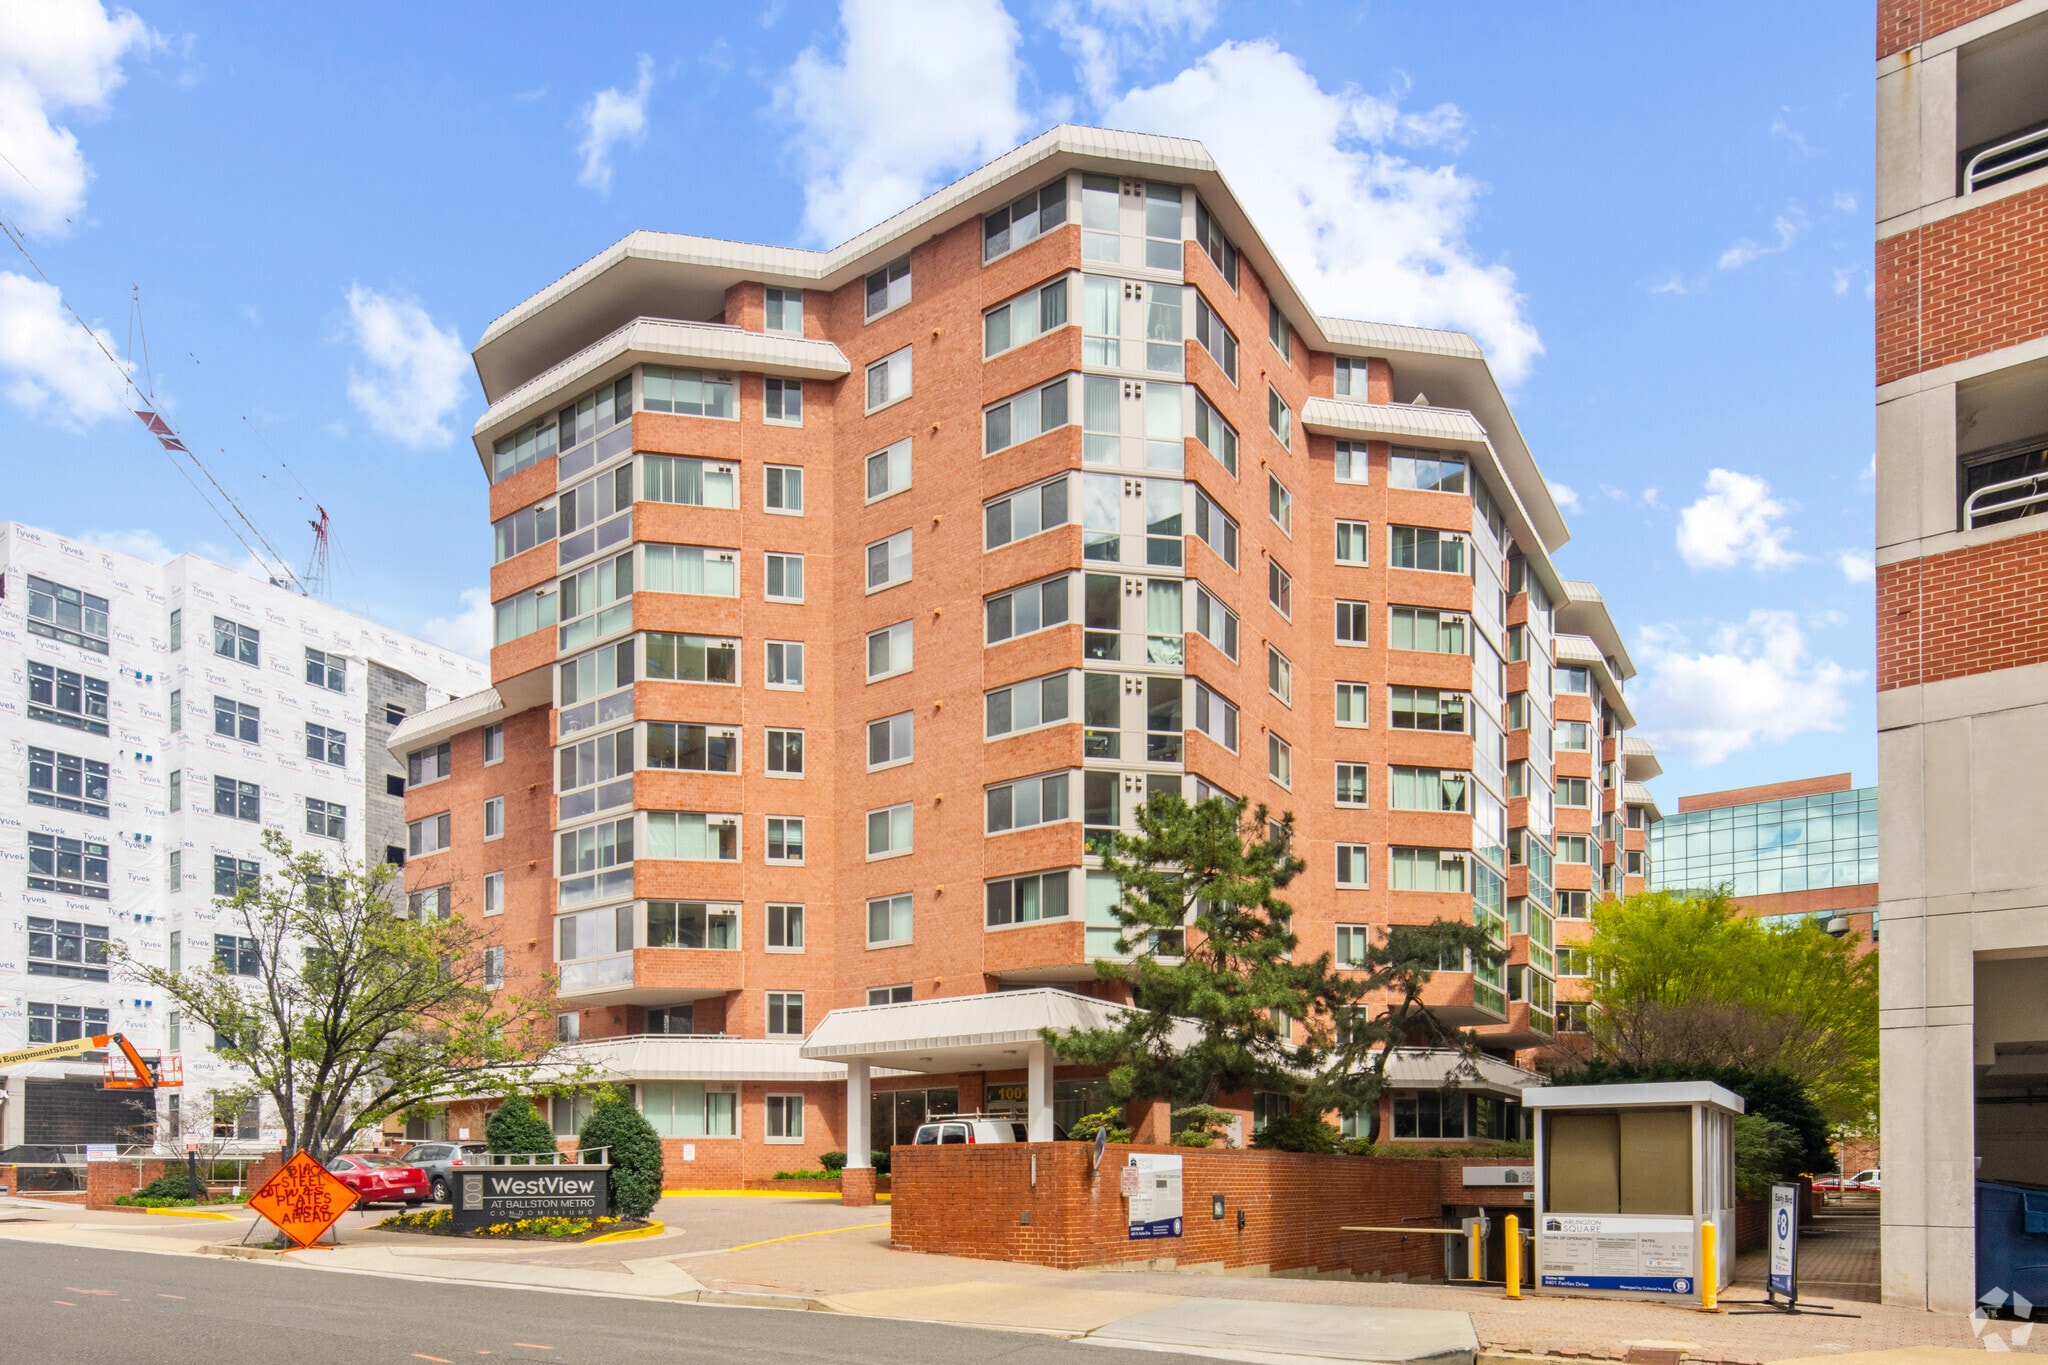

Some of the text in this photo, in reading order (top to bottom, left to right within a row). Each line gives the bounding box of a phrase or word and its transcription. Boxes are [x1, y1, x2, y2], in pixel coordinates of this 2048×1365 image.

[15, 527, 41, 542] Tyvek
[59, 542, 84, 557] Tyvek
[192, 585, 215, 599] Tyvek
[230, 598, 251, 612] Tyvek
[35, 639, 60, 652] Tyvek
[205, 670, 227, 683] Tyvek
[241, 682, 263, 695] Tyvek
[140, 705, 162, 719] Tyvek
[186, 702, 208, 716] Tyvek
[119, 730, 142, 743] Tyvek
[205, 736, 227, 750] Tyvek
[186, 770, 208, 783] Tyvek
[124, 840, 148, 851] Tyvek
[128, 872, 151, 883] Tyvek
[21, 893, 47, 905] Tyvek
[66, 900, 90, 912] Tyvek
[194, 910, 216, 921] Tyvek
[140, 939, 162, 950] Tyvek
[187, 938, 209, 948] Tyvek
[125, 1020, 148, 1031] Tyvek
[2, 1043, 80, 1064] EquipmentShare
[999, 1087, 1029, 1100] 1001
[282, 1175, 326, 1188] STEEL
[491, 1177, 595, 1195] WestView
[465, 1176, 482, 1209] 1001
[276, 1193, 332, 1206] PLATES
[491, 1199, 595, 1209] AT BALLSTON METRO
[281, 1212, 332, 1224] AHEAD
[1563, 1225, 1601, 1233] SQUARE
